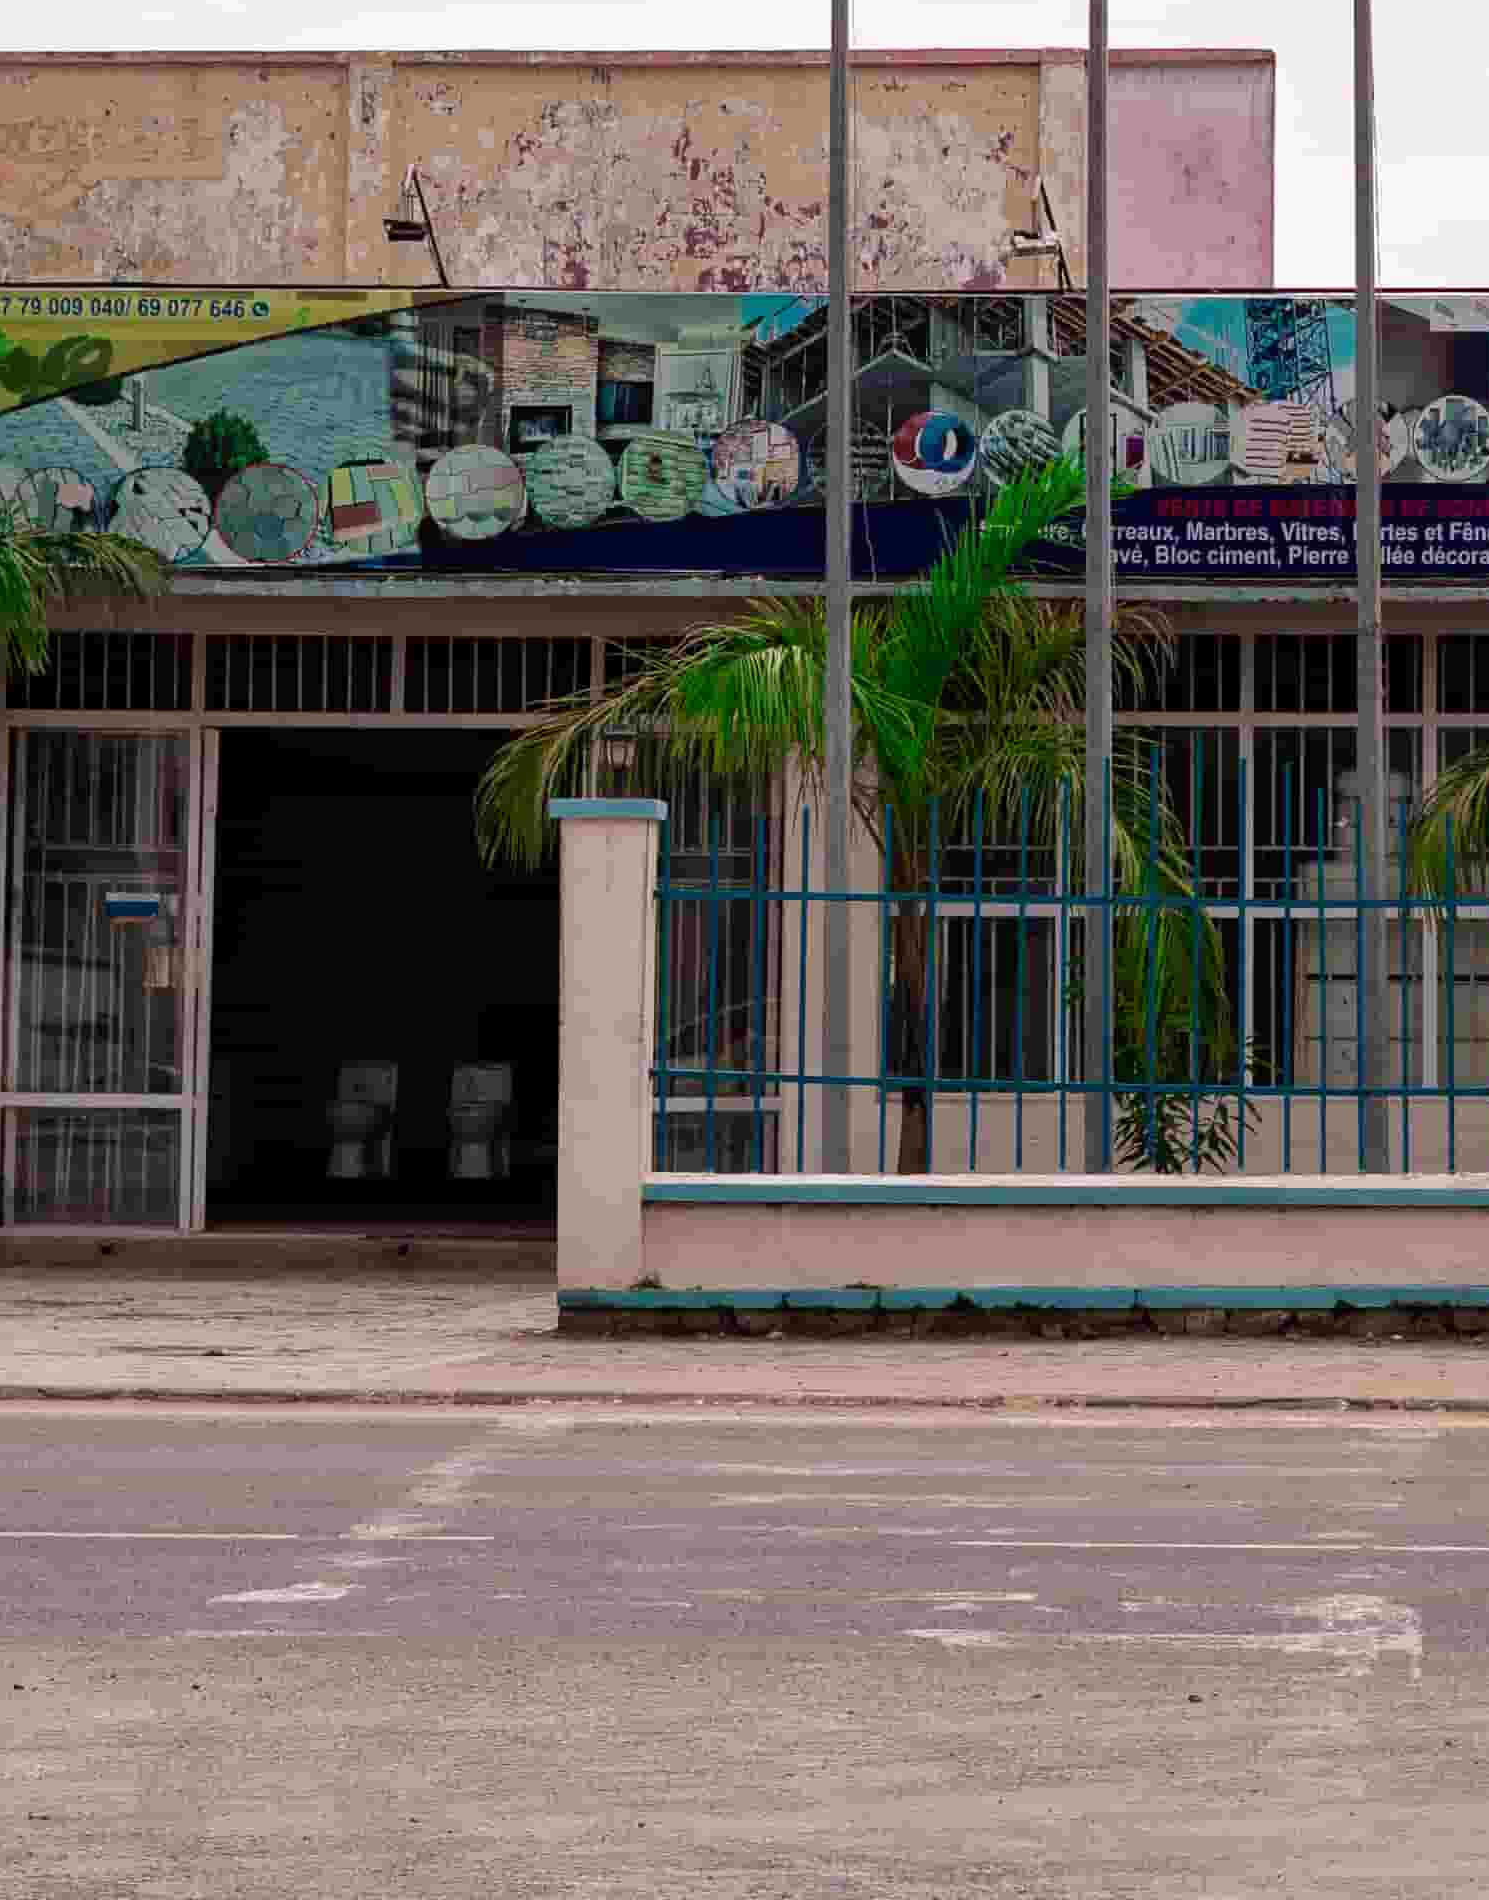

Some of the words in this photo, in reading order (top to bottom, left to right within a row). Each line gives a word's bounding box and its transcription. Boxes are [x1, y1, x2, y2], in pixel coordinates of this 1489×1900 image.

[18, 296, 41, 316] 79
[47, 296, 83, 316] 009
[137, 297, 161, 317] 69
[167, 297, 203, 317] 077
[1186, 521, 1274, 544] Marbres,
[1280, 521, 1346, 544] Vitres,
[1424, 523, 1444, 541] et
[1155, 545, 1201, 565] Bloc
[1206, 545, 1282, 569] ciment,
[1288, 545, 1350, 565] Pierre
